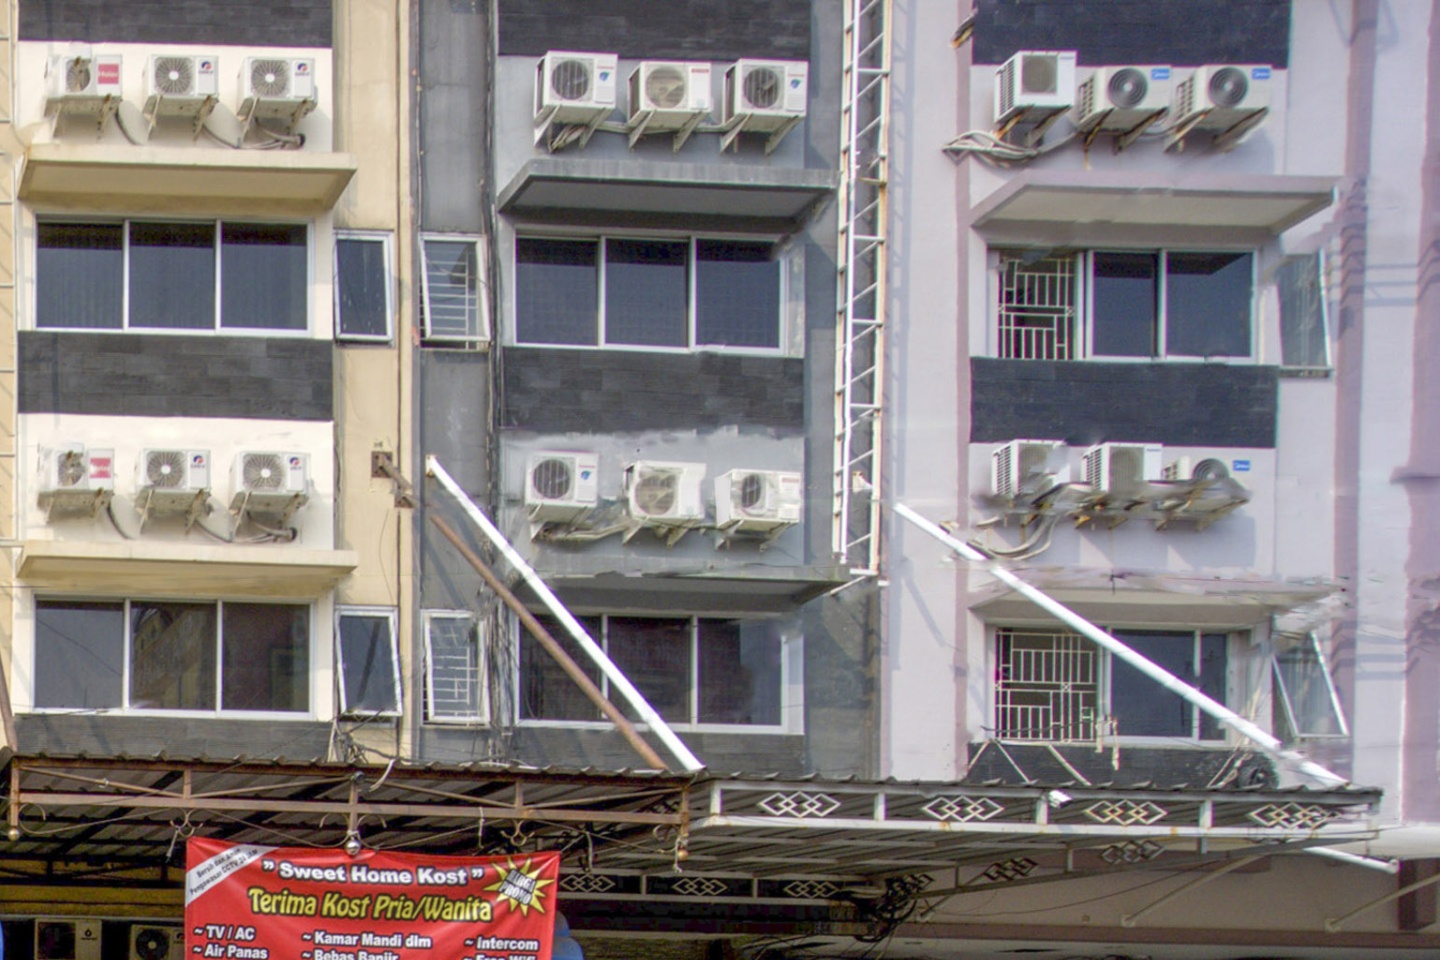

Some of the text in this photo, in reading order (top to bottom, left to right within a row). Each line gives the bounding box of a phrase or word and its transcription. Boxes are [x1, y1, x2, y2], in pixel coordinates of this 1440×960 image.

[279, 861, 347, 881] Sweet
[351, 866, 413, 884] Home
[417, 867, 467, 885] Kost
[248, 888, 492, 921] Terima Kost Pria/Wanita
[206, 925, 225, 939] TV
[235, 927, 255, 940] AC
[314, 931, 432, 948] Kamar Mandi dlm
[204, 944, 268, 960] Air Panas
[477, 937, 539, 951] Intercom
